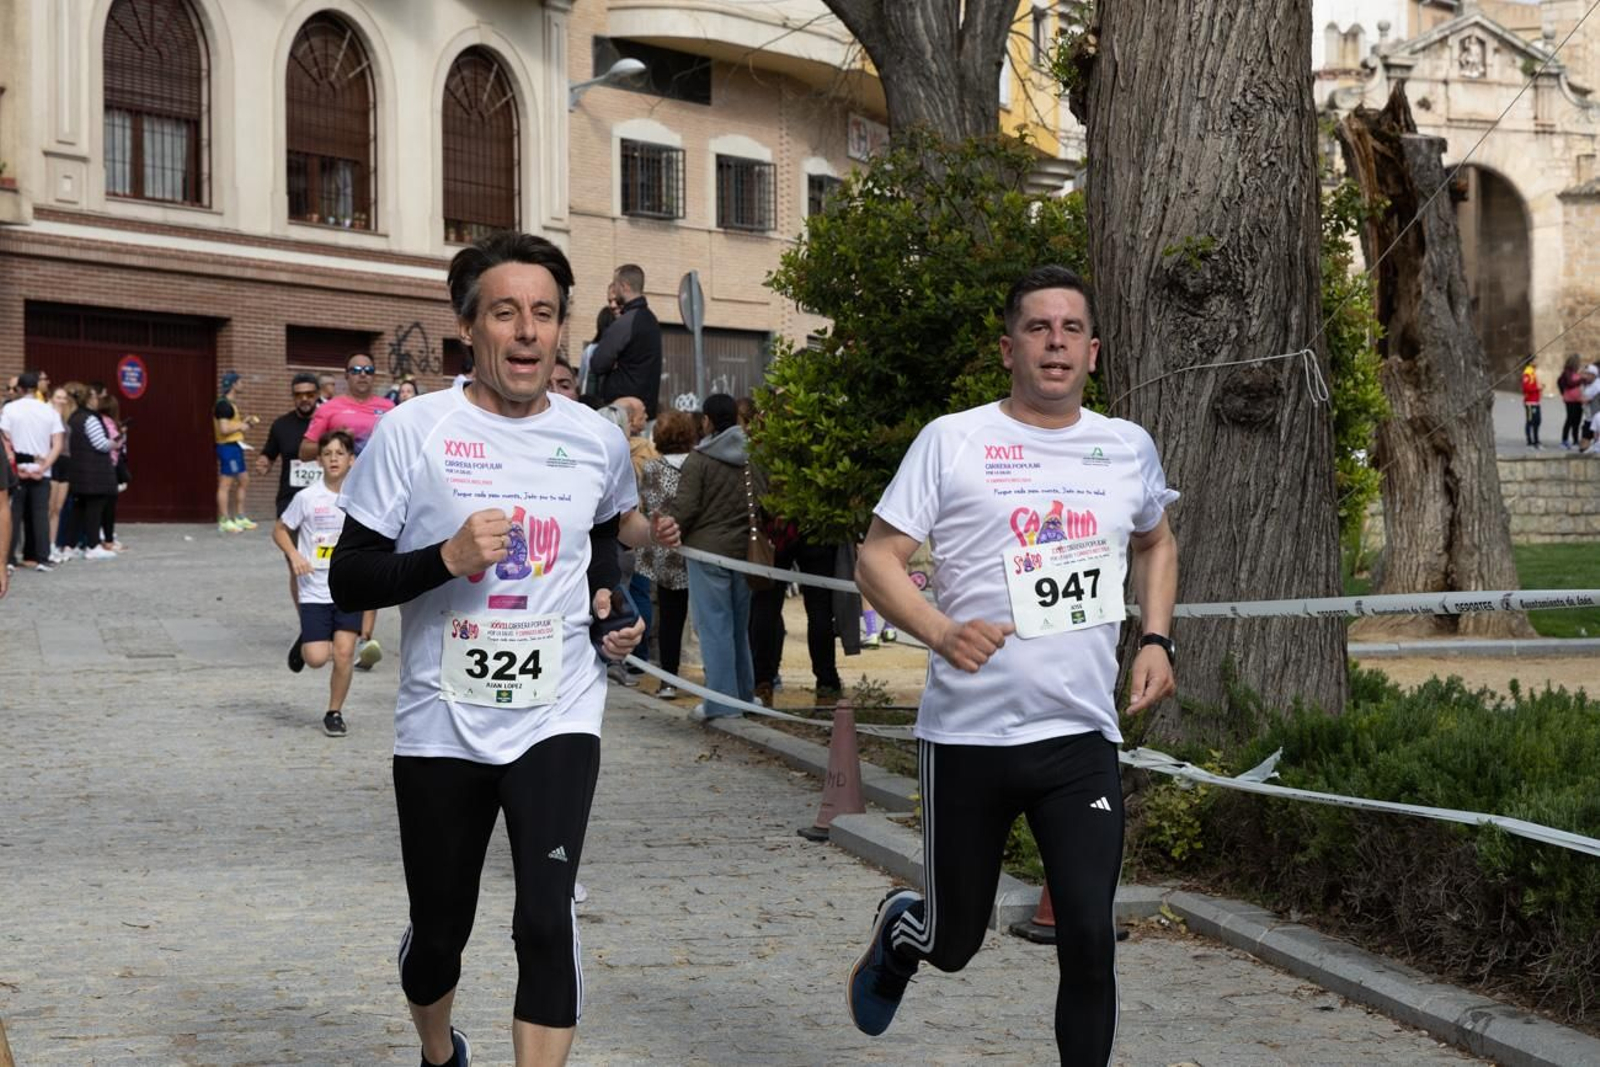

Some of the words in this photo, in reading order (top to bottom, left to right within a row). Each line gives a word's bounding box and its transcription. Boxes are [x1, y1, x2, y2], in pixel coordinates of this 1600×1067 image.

[444, 440, 485, 459] XXVII
[984, 444, 1024, 460] XXVII
[294, 470, 322, 479] 1207
[1034, 568, 1101, 607] 947
[1455, 601, 1495, 612] DEPORTES
[465, 648, 542, 681] 324
